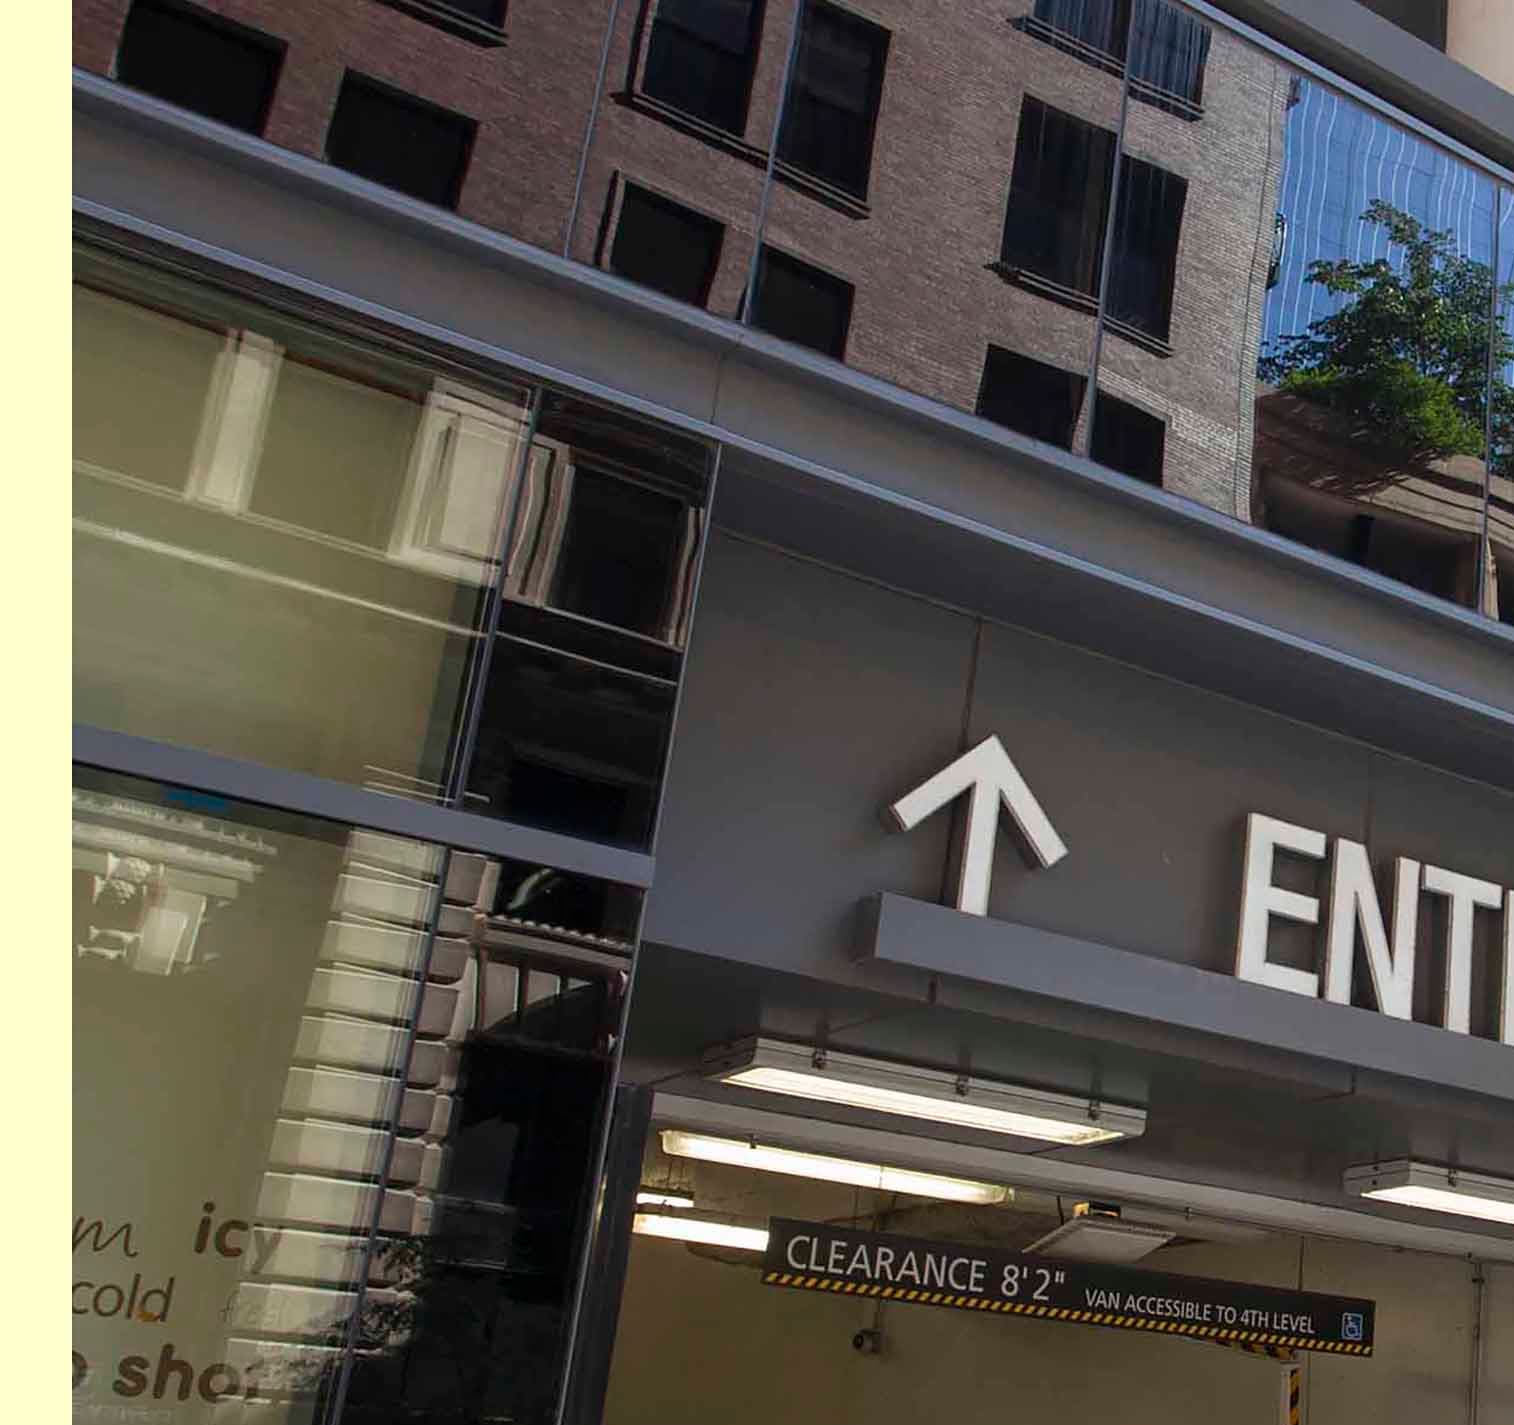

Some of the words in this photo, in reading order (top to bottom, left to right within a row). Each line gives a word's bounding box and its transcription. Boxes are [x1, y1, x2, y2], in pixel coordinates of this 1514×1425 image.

[193, 1201, 283, 1275] icy
[72, 1273, 176, 1322] cold
[786, 1235, 988, 1293] CLEARANCE
[1085, 1288, 1121, 1311] VAN
[1124, 1296, 1212, 1322] ACCESSIBLE
[1215, 1305, 1237, 1325] TO
[1240, 1309, 1270, 1328] 4TH
[1273, 1312, 1316, 1335] LEVEL
